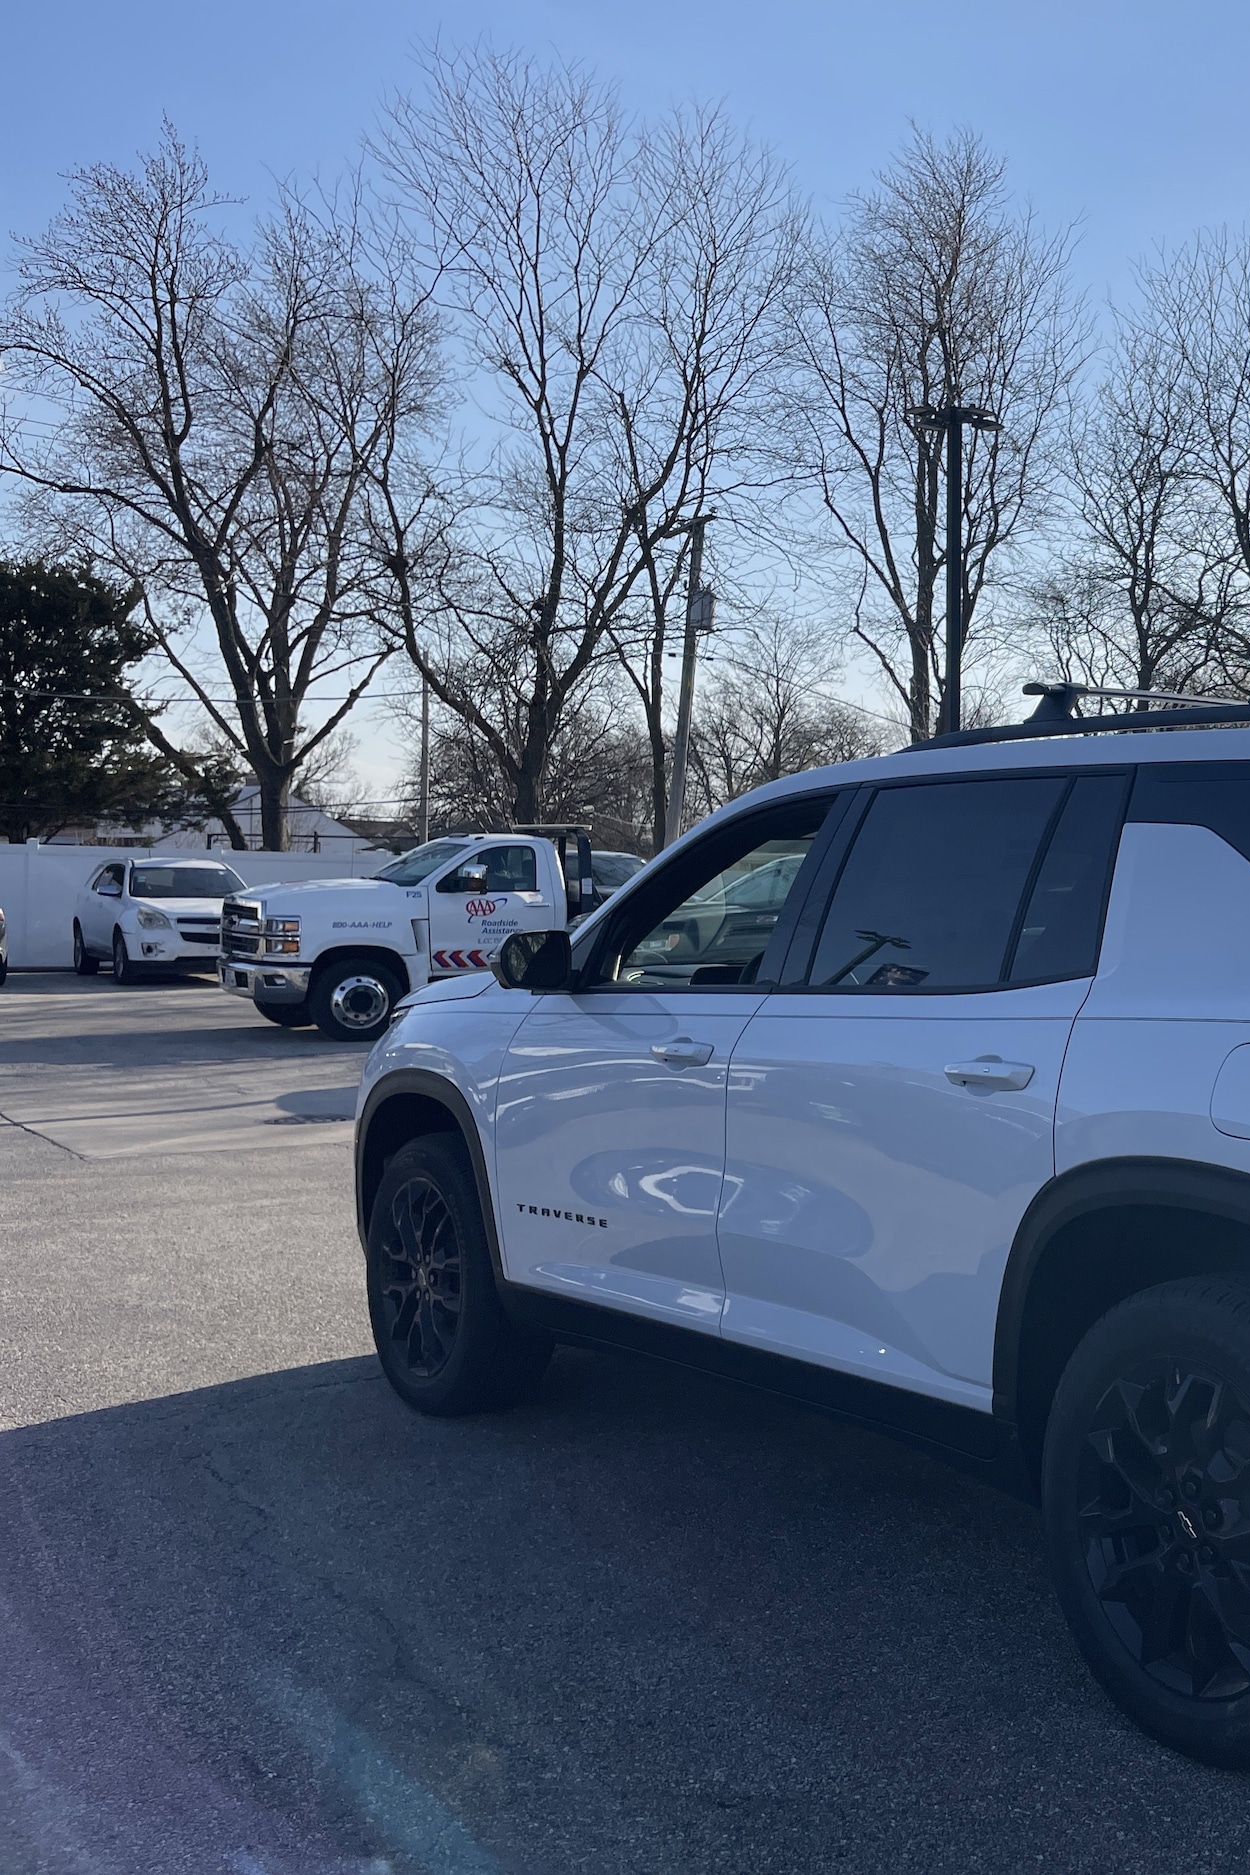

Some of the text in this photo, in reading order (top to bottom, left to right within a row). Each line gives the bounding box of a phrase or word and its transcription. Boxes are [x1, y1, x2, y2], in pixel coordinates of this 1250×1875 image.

[466, 899, 496, 916] AAA
[481, 919, 518, 927] Roadside
[516, 1203, 608, 1228] TRAVERSE
